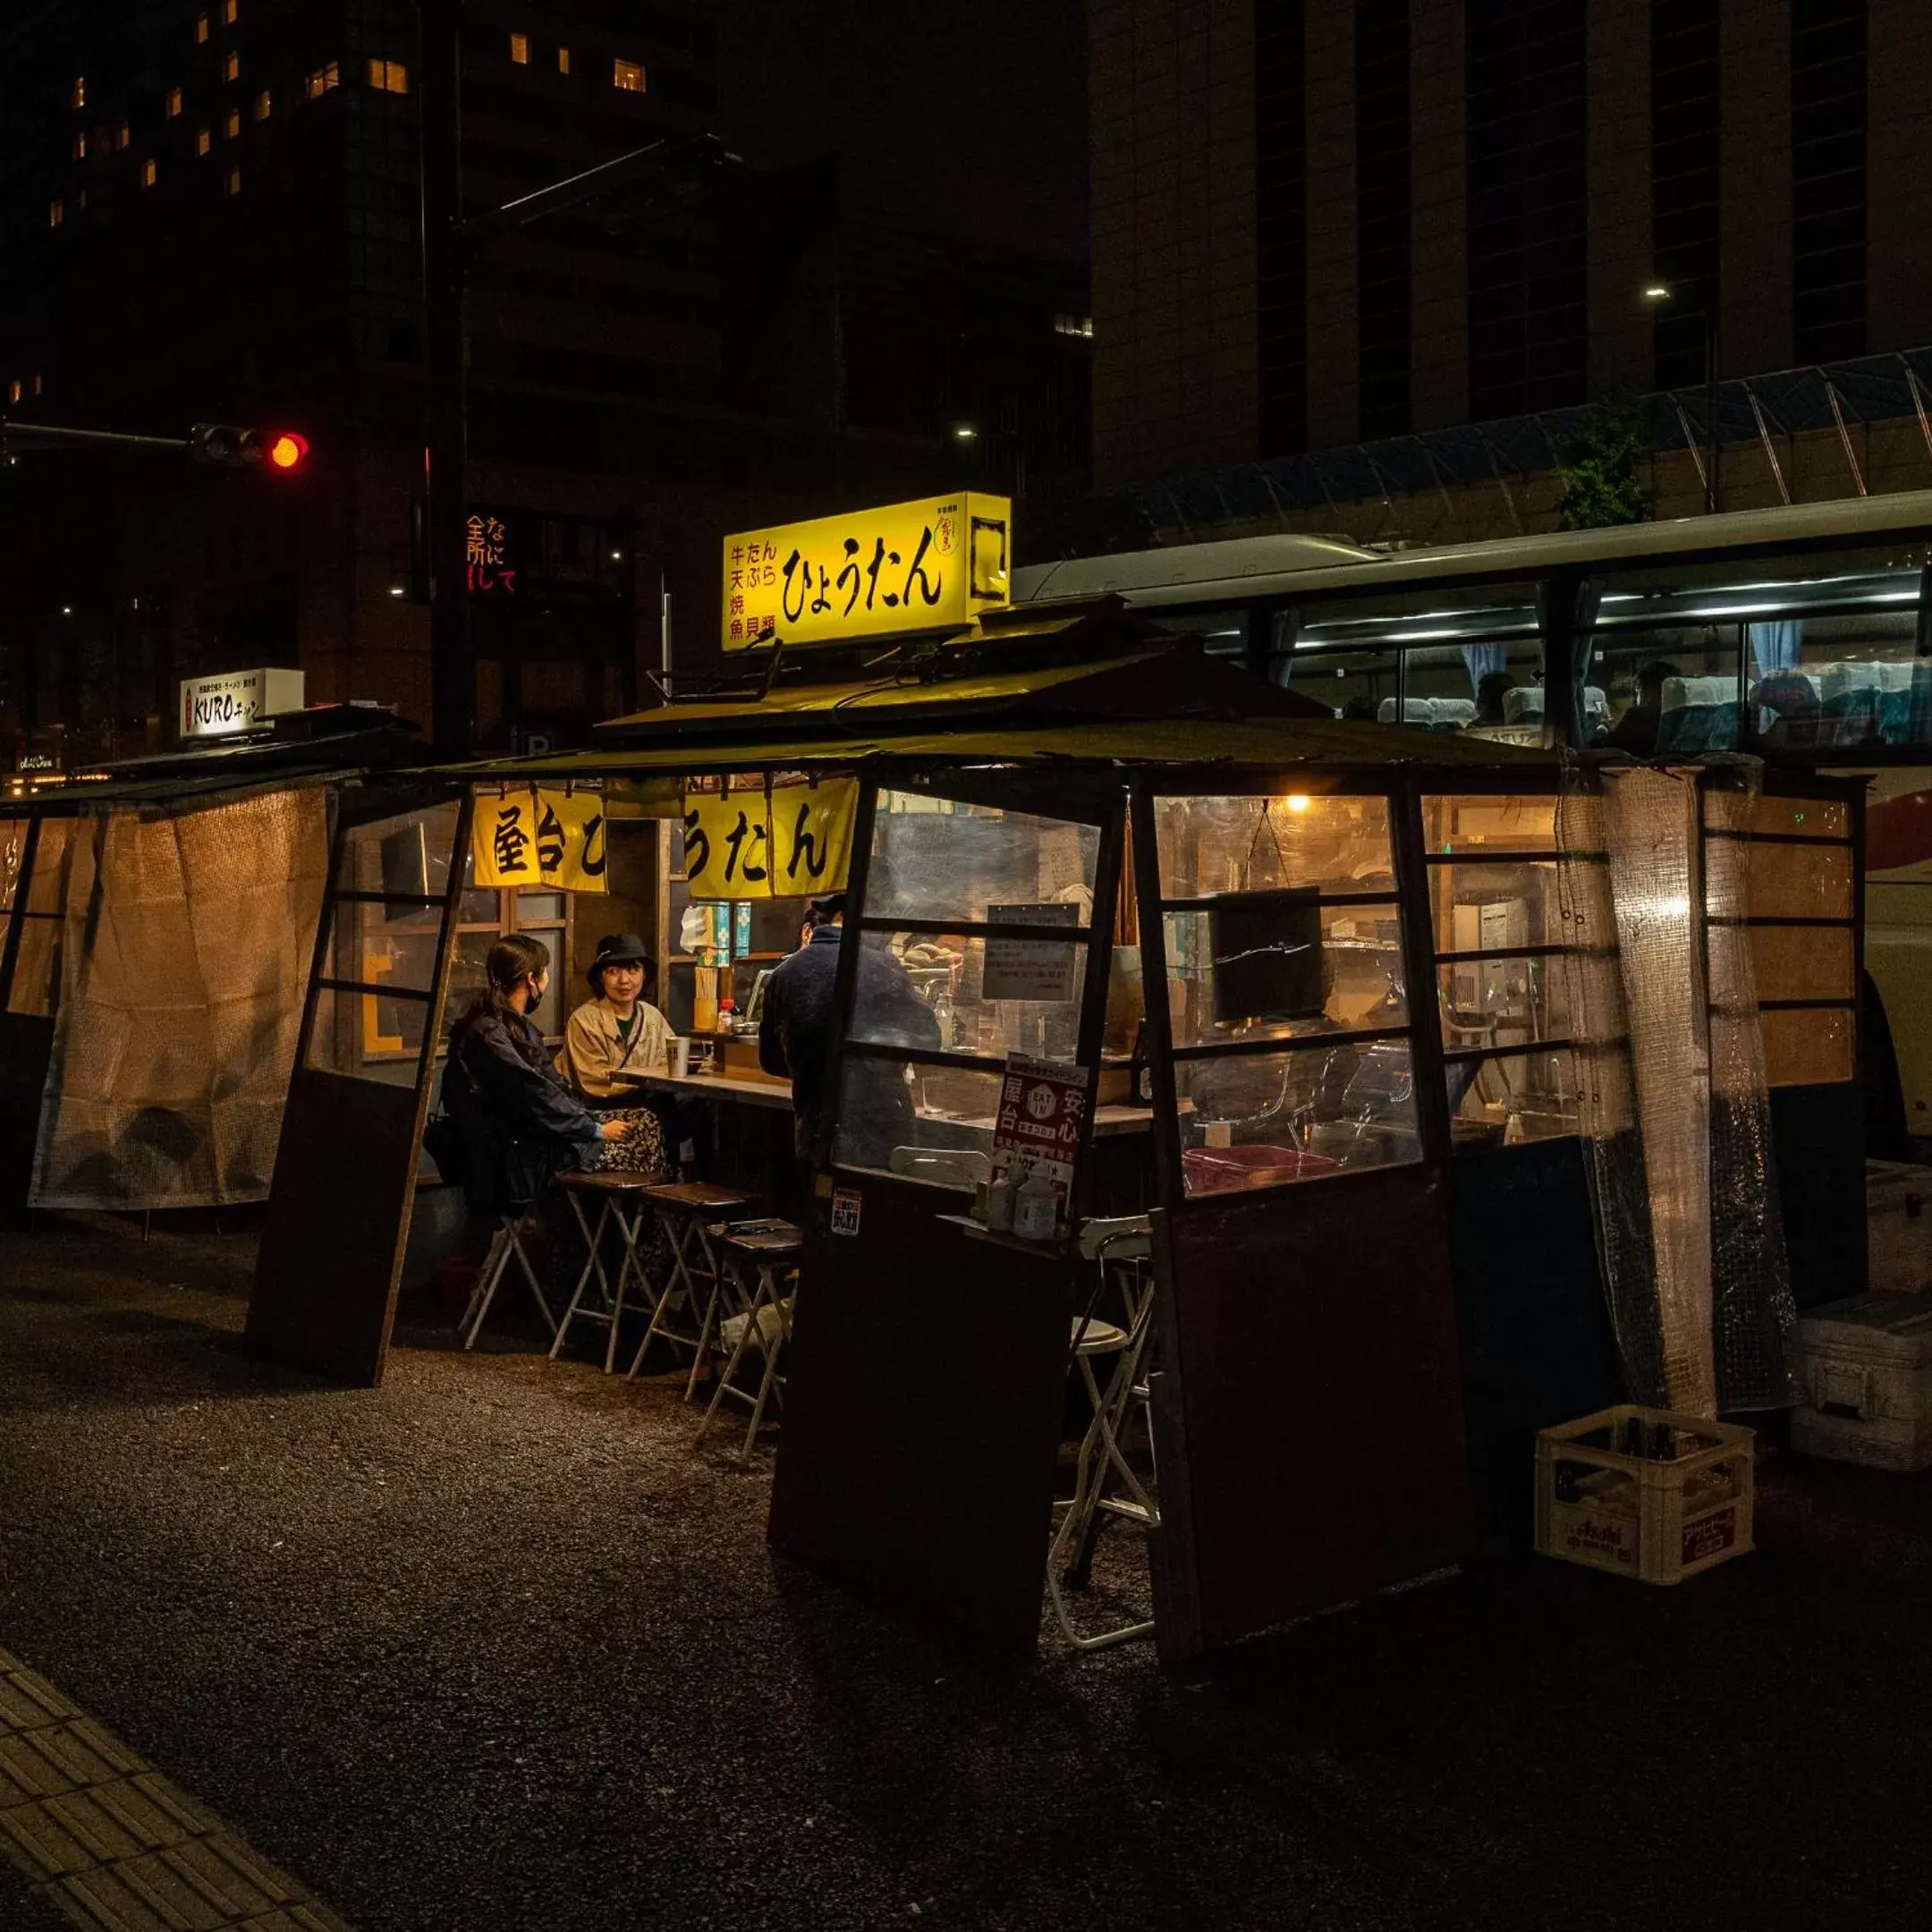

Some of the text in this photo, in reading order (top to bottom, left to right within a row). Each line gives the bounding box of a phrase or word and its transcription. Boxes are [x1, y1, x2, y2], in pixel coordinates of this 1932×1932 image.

[730, 539, 776, 565] 牛たん
[730, 566, 776, 591] 天ぷら
[782, 525, 942, 623] ひょうたん
[1001, 1077, 1023, 1131] 屋台
[1058, 1088, 1083, 1143] 安心
